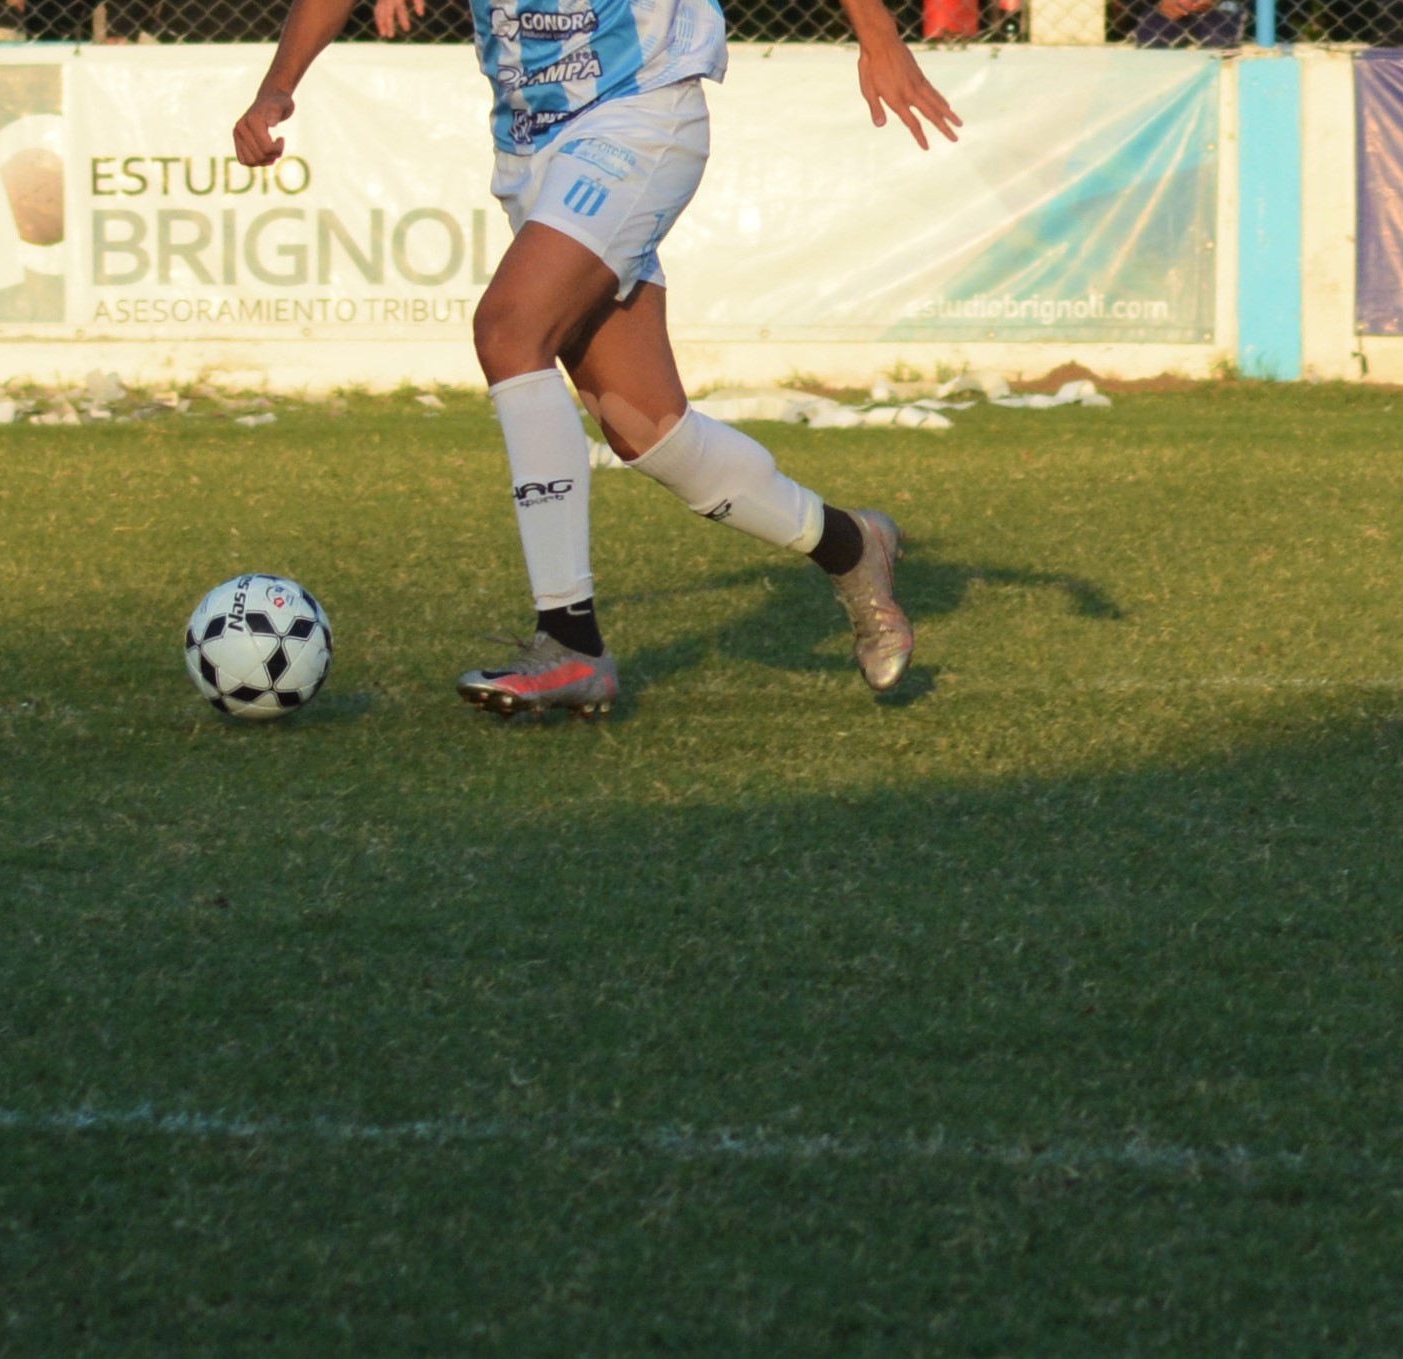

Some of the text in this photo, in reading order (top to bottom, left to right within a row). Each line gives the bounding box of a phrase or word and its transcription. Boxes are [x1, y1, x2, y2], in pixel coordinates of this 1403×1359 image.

[520, 11, 596, 33] GONDRA
[514, 59, 601, 89] PAMPA
[91, 154, 311, 196] ESTUDIO
[90, 206, 496, 288] BRIGNOL
[95, 298, 357, 324] ASESORAMIENTO
[902, 294, 1169, 326] estudiobrignoli.com
